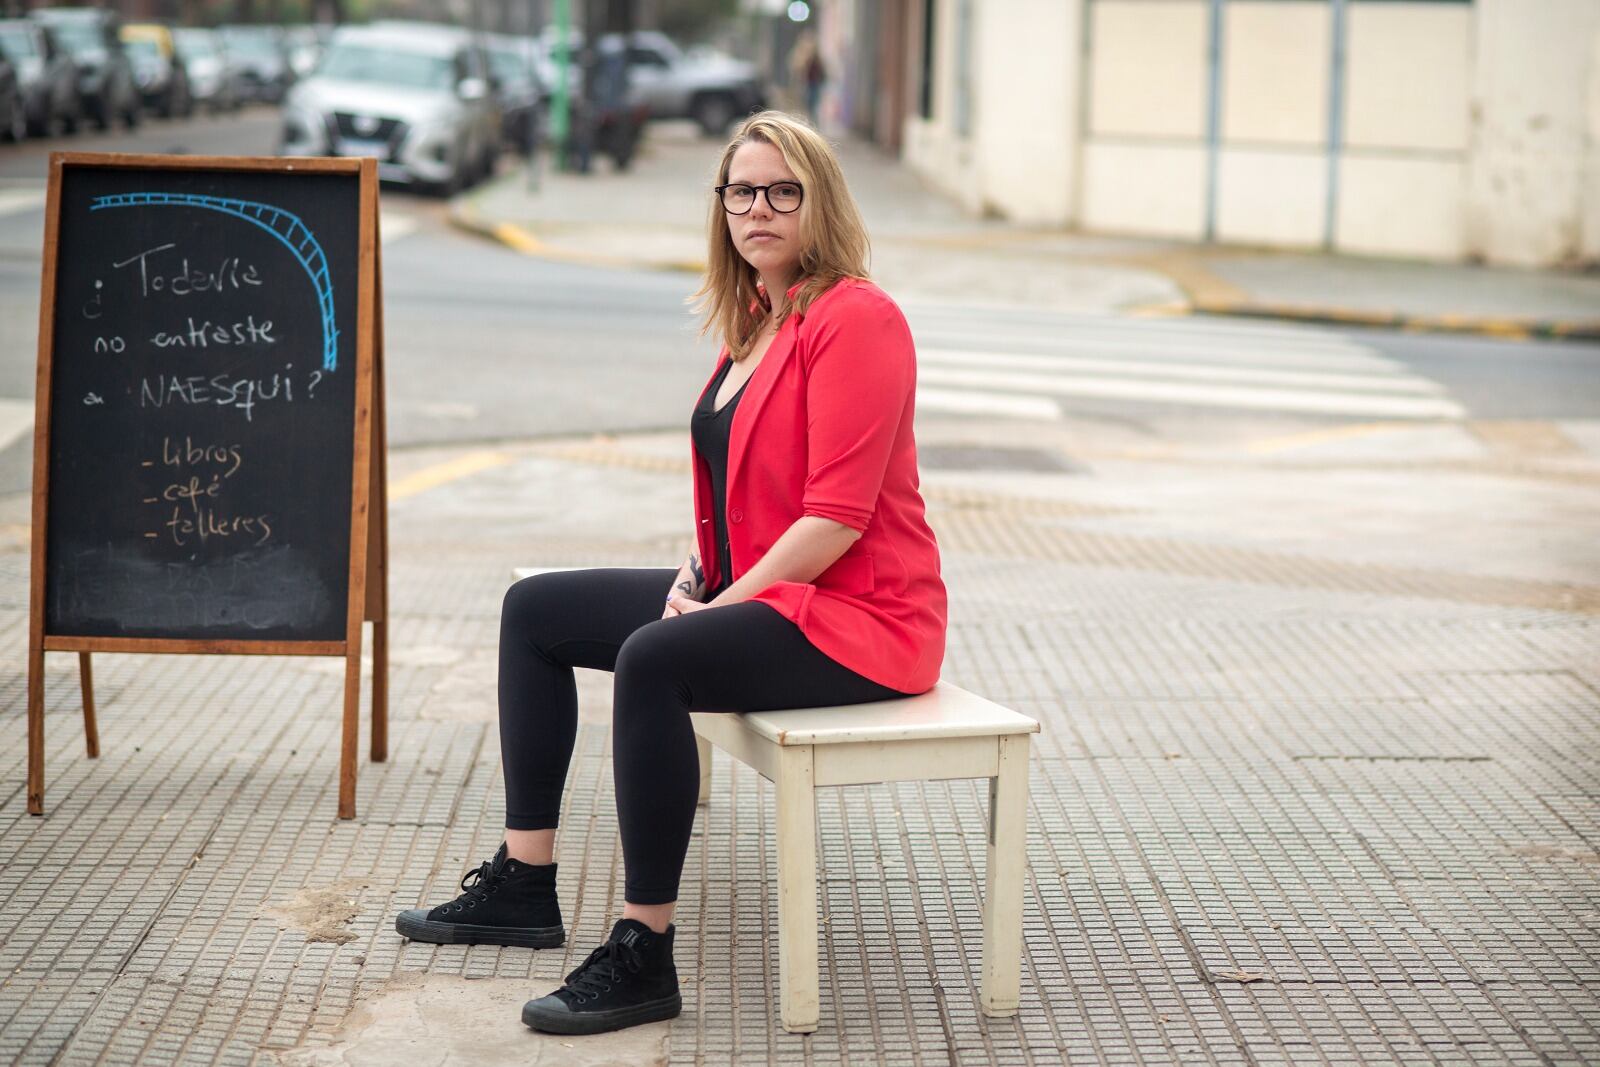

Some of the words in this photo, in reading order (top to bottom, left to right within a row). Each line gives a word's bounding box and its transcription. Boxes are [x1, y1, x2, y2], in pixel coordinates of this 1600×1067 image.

[94, 336, 126, 353] no
[150, 315, 276, 348] entraste
[163, 436, 241, 478] libros
[163, 474, 220, 513] café
[166, 506, 271, 546] talleres
